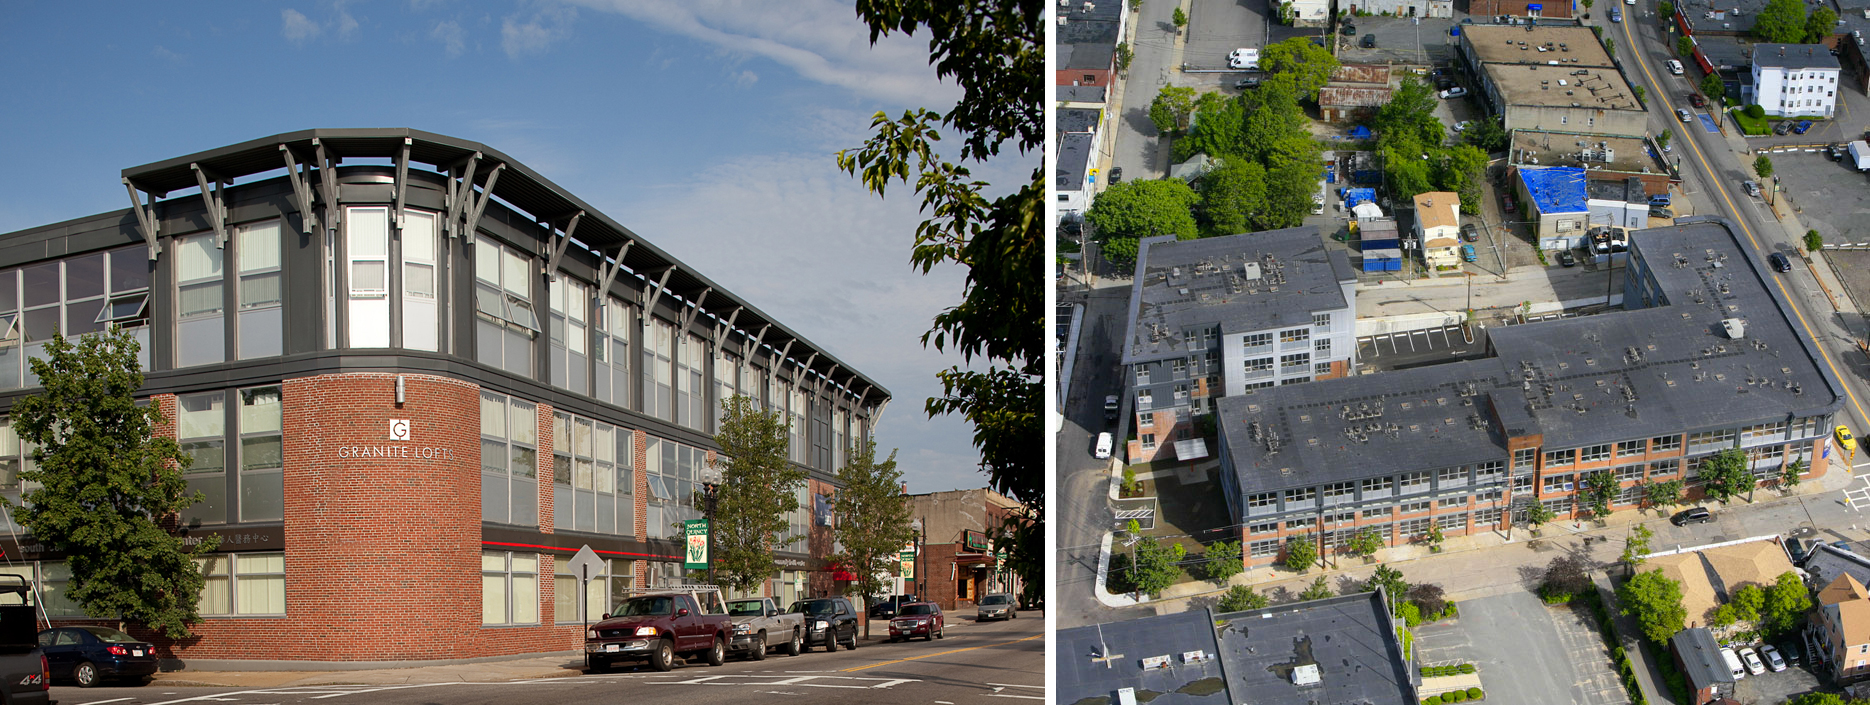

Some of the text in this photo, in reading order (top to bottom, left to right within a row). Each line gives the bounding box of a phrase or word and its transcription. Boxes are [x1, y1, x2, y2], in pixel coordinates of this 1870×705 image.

[392, 420, 408, 439] G
[338, 446, 454, 461] GRANITE LOFTS
